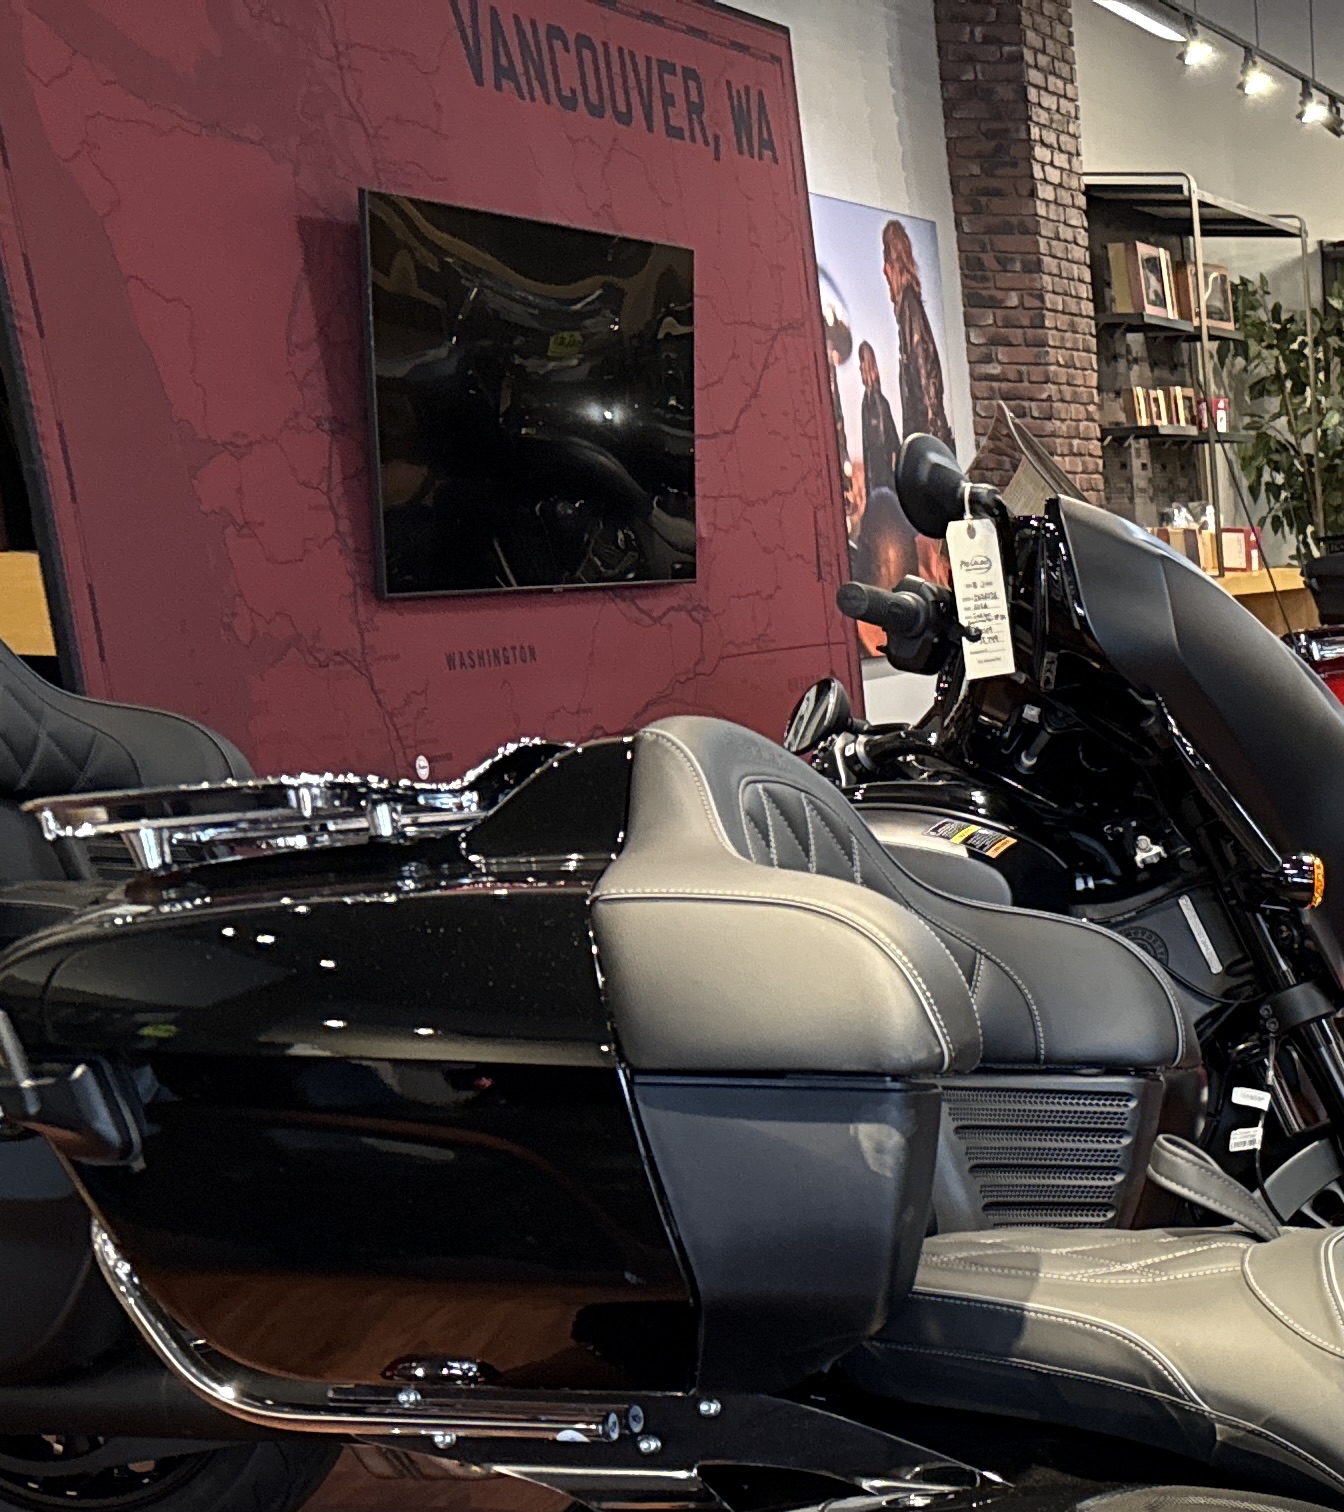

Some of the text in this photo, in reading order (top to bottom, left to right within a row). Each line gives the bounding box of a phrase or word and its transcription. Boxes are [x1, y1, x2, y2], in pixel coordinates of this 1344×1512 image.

[450, 0, 779, 165] VANCOUVER, WA
[445, 645, 537, 672] WASHINGTON
